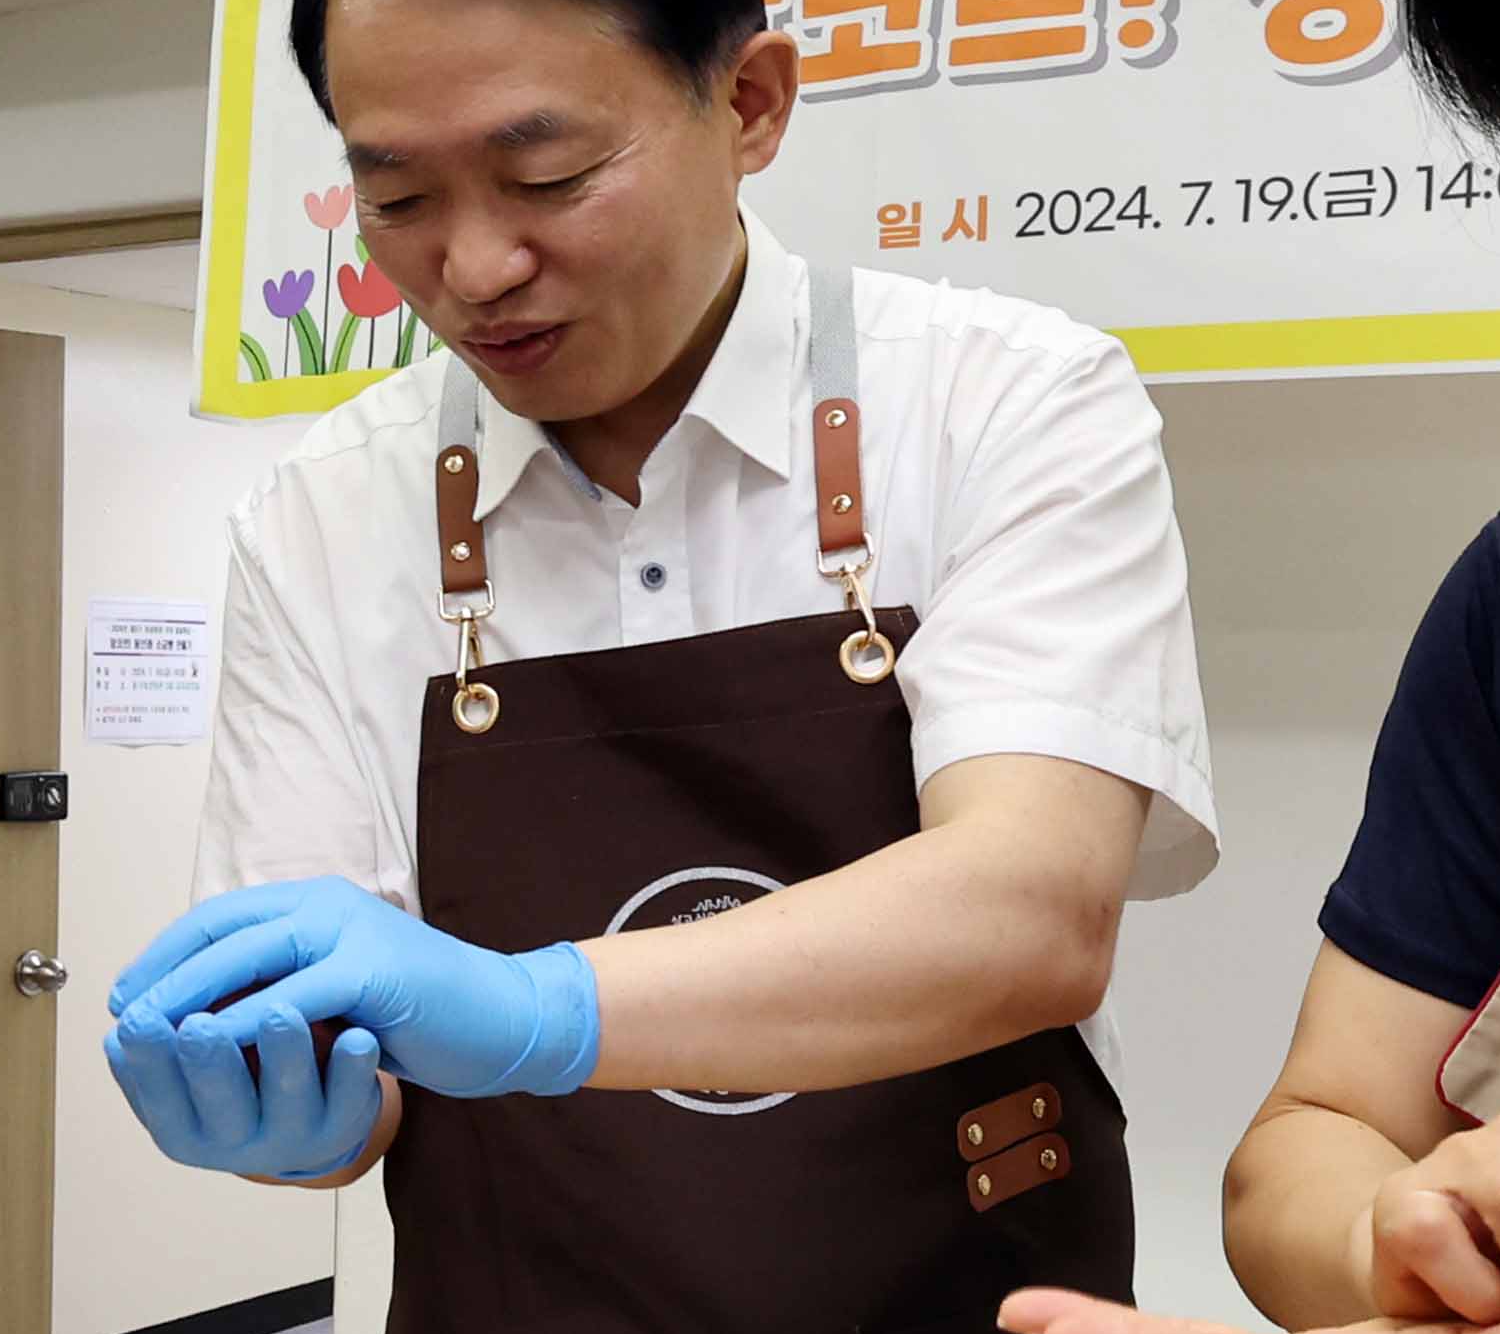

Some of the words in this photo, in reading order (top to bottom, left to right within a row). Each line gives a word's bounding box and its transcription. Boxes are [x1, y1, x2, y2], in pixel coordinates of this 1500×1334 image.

[1014, 184, 1160, 238] 2024.
[1180, 178, 1215, 227] 7.
[1234, 166, 1399, 224] 19.(금)
